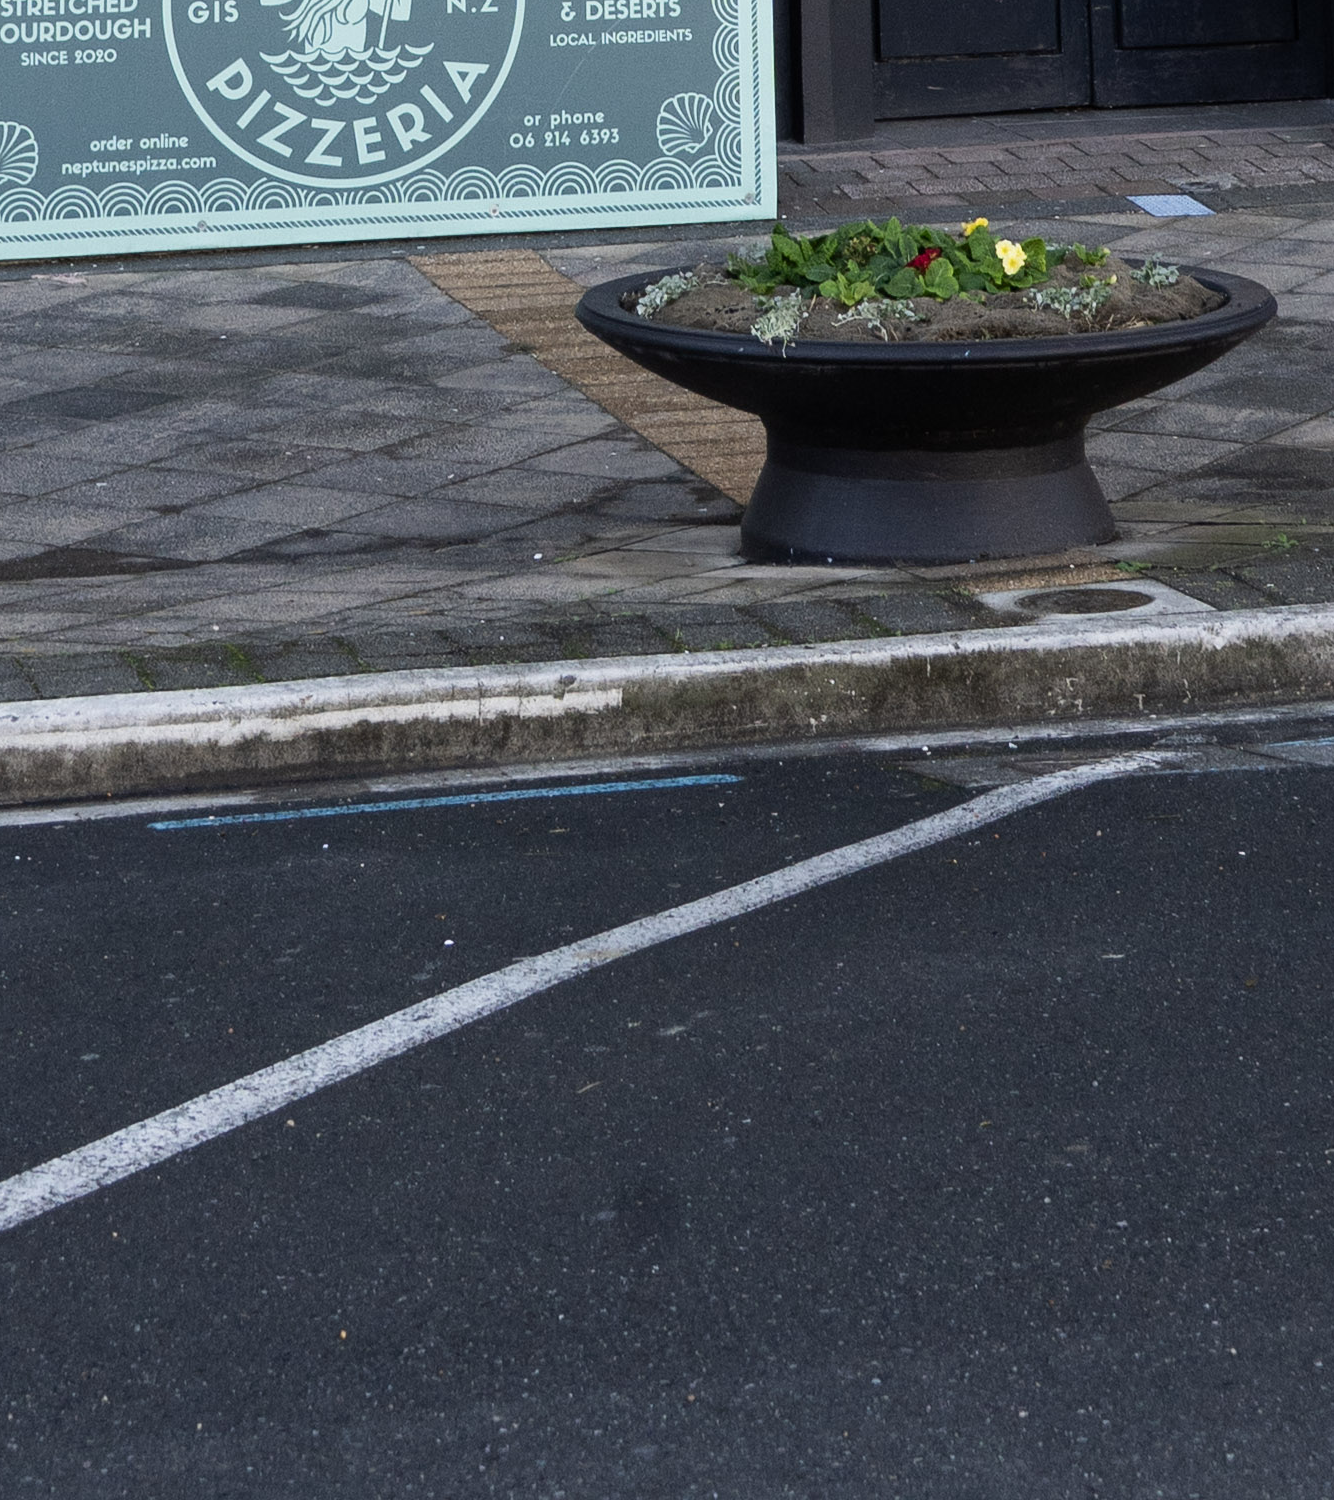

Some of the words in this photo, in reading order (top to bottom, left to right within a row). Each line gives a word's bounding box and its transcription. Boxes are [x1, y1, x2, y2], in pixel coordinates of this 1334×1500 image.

[187, 0, 239, 24] GIS
[561, 2, 576, 21] &
[550, 33, 596, 47] LOCAL
[601, 29, 692, 45] INGREDIENTS
[21, 50, 68, 66] SINCE
[74, 49, 117, 64] 2020
[206, 57, 490, 167] PIZZERIA
[524, 115, 541, 126] or
[551, 110, 604, 129] phone
[90, 135, 133, 152] order
[140, 133, 189, 150] online
[510, 132, 535, 148] 06
[544, 130, 571, 147] 214
[580, 128, 619, 145] 6393
[62, 156, 217, 178] neptunespizza.com
